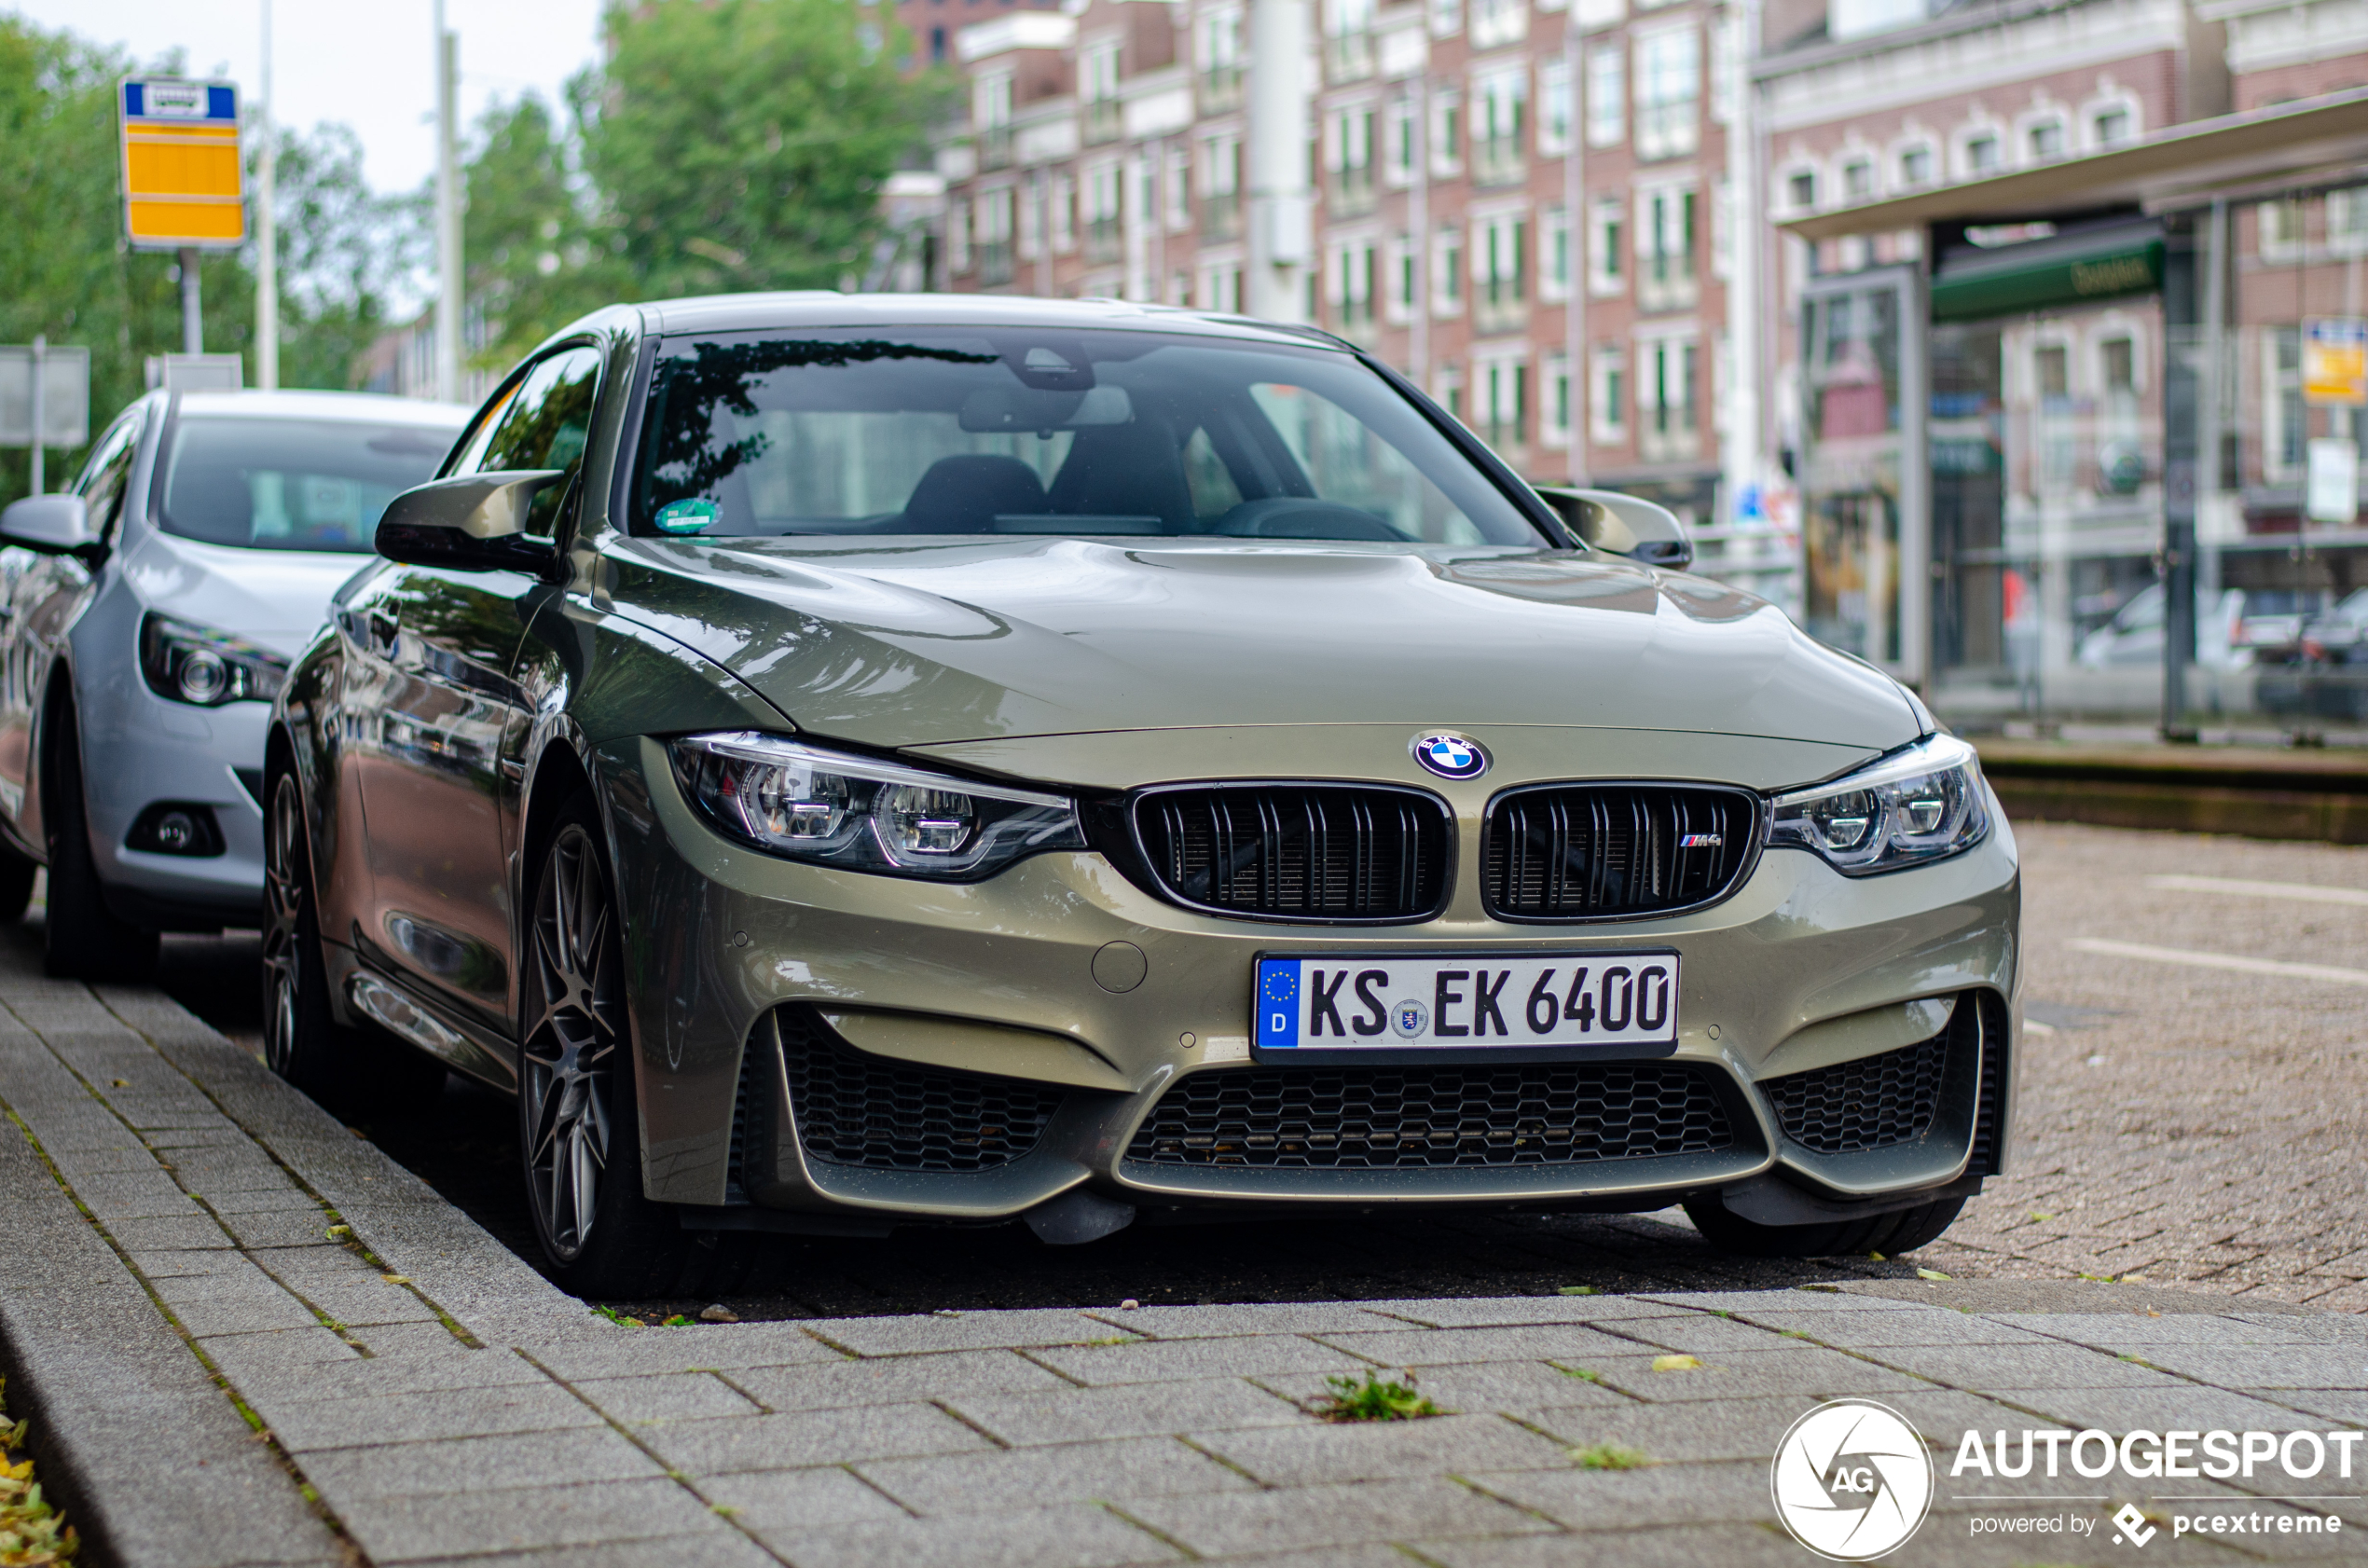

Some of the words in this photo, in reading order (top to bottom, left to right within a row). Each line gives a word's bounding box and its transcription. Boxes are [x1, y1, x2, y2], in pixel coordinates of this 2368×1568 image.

[1419, 736, 1475, 750] BMW
[1691, 833, 1722, 846] M4
[1310, 968, 1389, 1037] KS
[1434, 970, 1512, 1037] EK
[1526, 965, 1670, 1035] 6400
[1271, 1012, 1287, 1032] D
